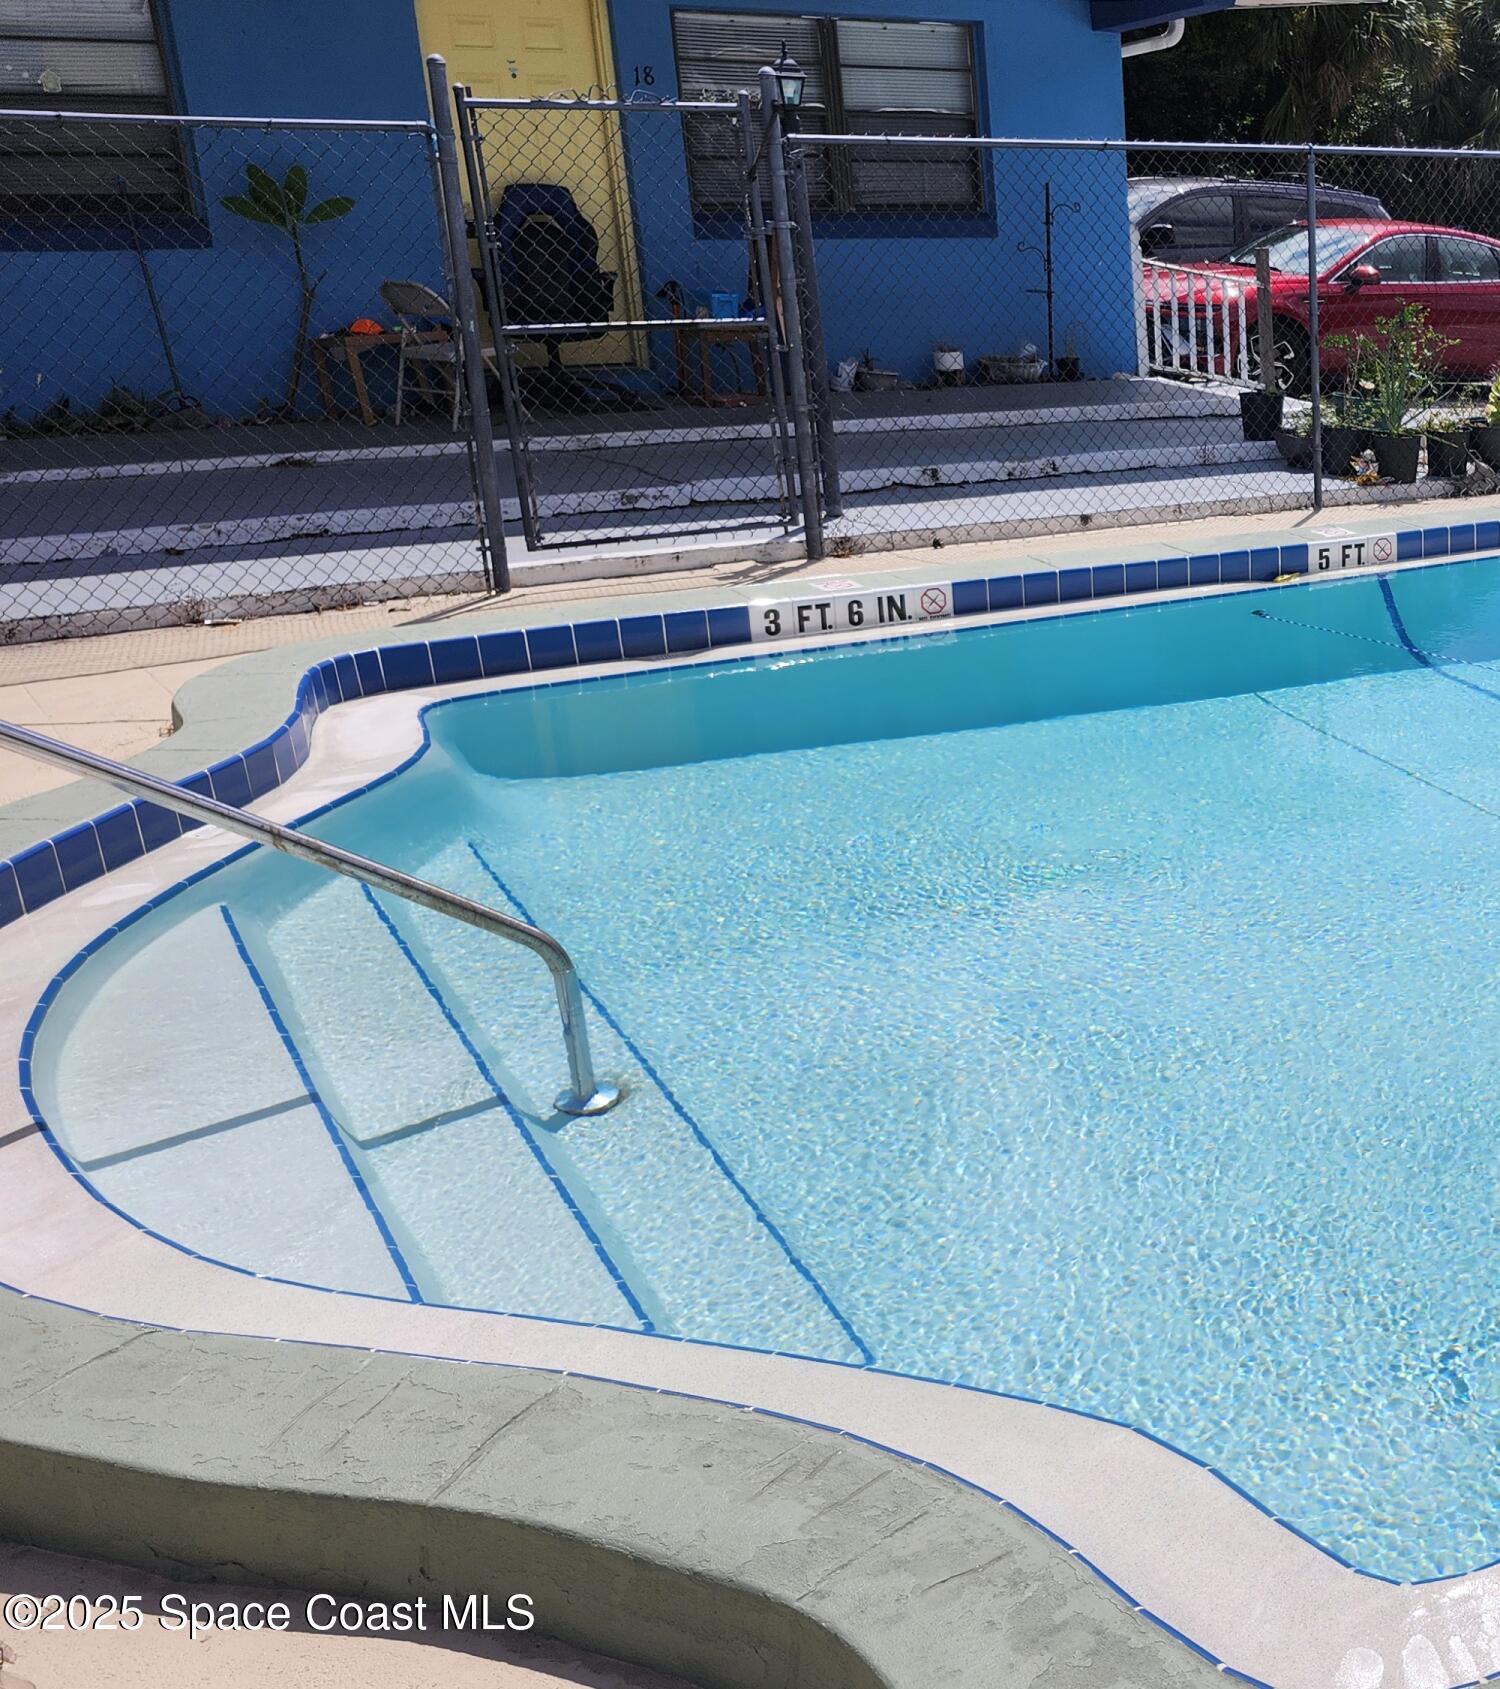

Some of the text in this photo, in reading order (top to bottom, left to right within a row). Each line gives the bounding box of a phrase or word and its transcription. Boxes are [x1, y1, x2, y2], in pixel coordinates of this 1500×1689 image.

[634, 65, 655, 86] 18
[1318, 548, 1330, 570] 5
[764, 594, 913, 636] 3 FT. 6 IN.
